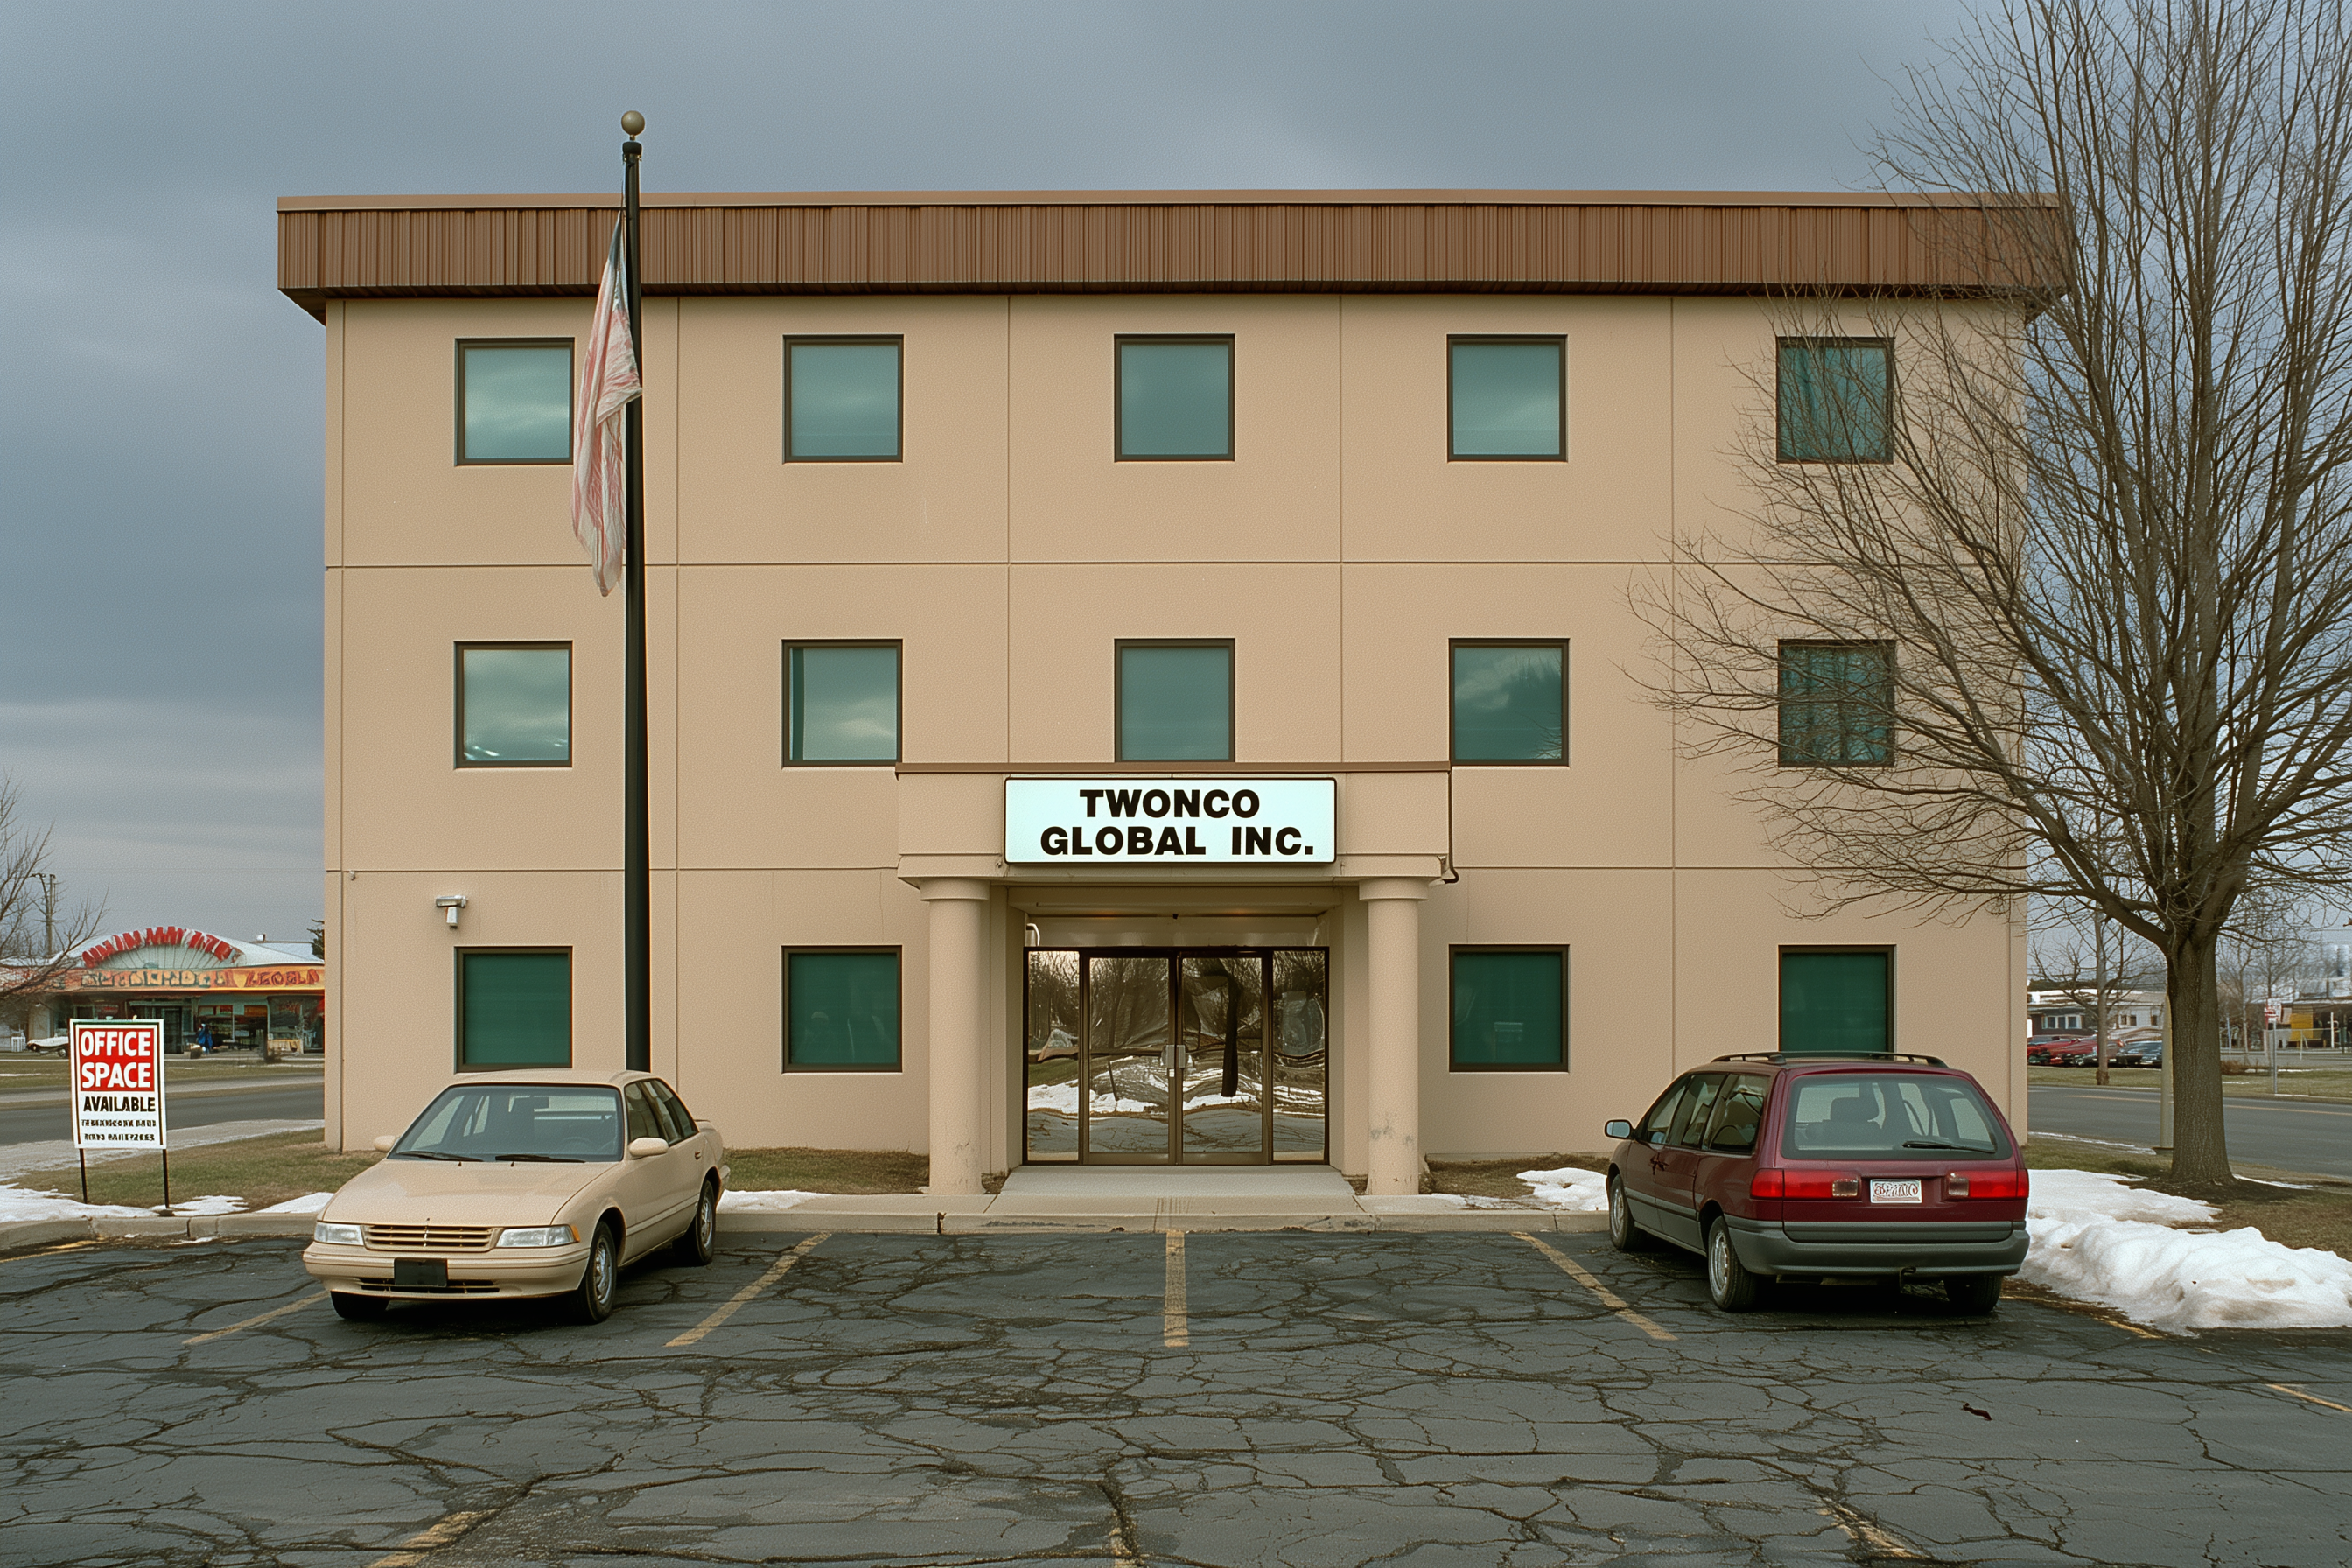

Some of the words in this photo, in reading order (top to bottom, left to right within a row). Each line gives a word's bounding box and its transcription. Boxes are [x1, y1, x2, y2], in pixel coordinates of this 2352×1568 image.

[1080, 789, 1260, 818] TWONCO
[1040, 826, 1206, 856] GLOBAL
[1232, 826, 1313, 856] INC.
[80, 1031, 151, 1056] OFFICE
[81, 1062, 151, 1088] SPACE
[83, 1096, 156, 1112] AVAILABLE
